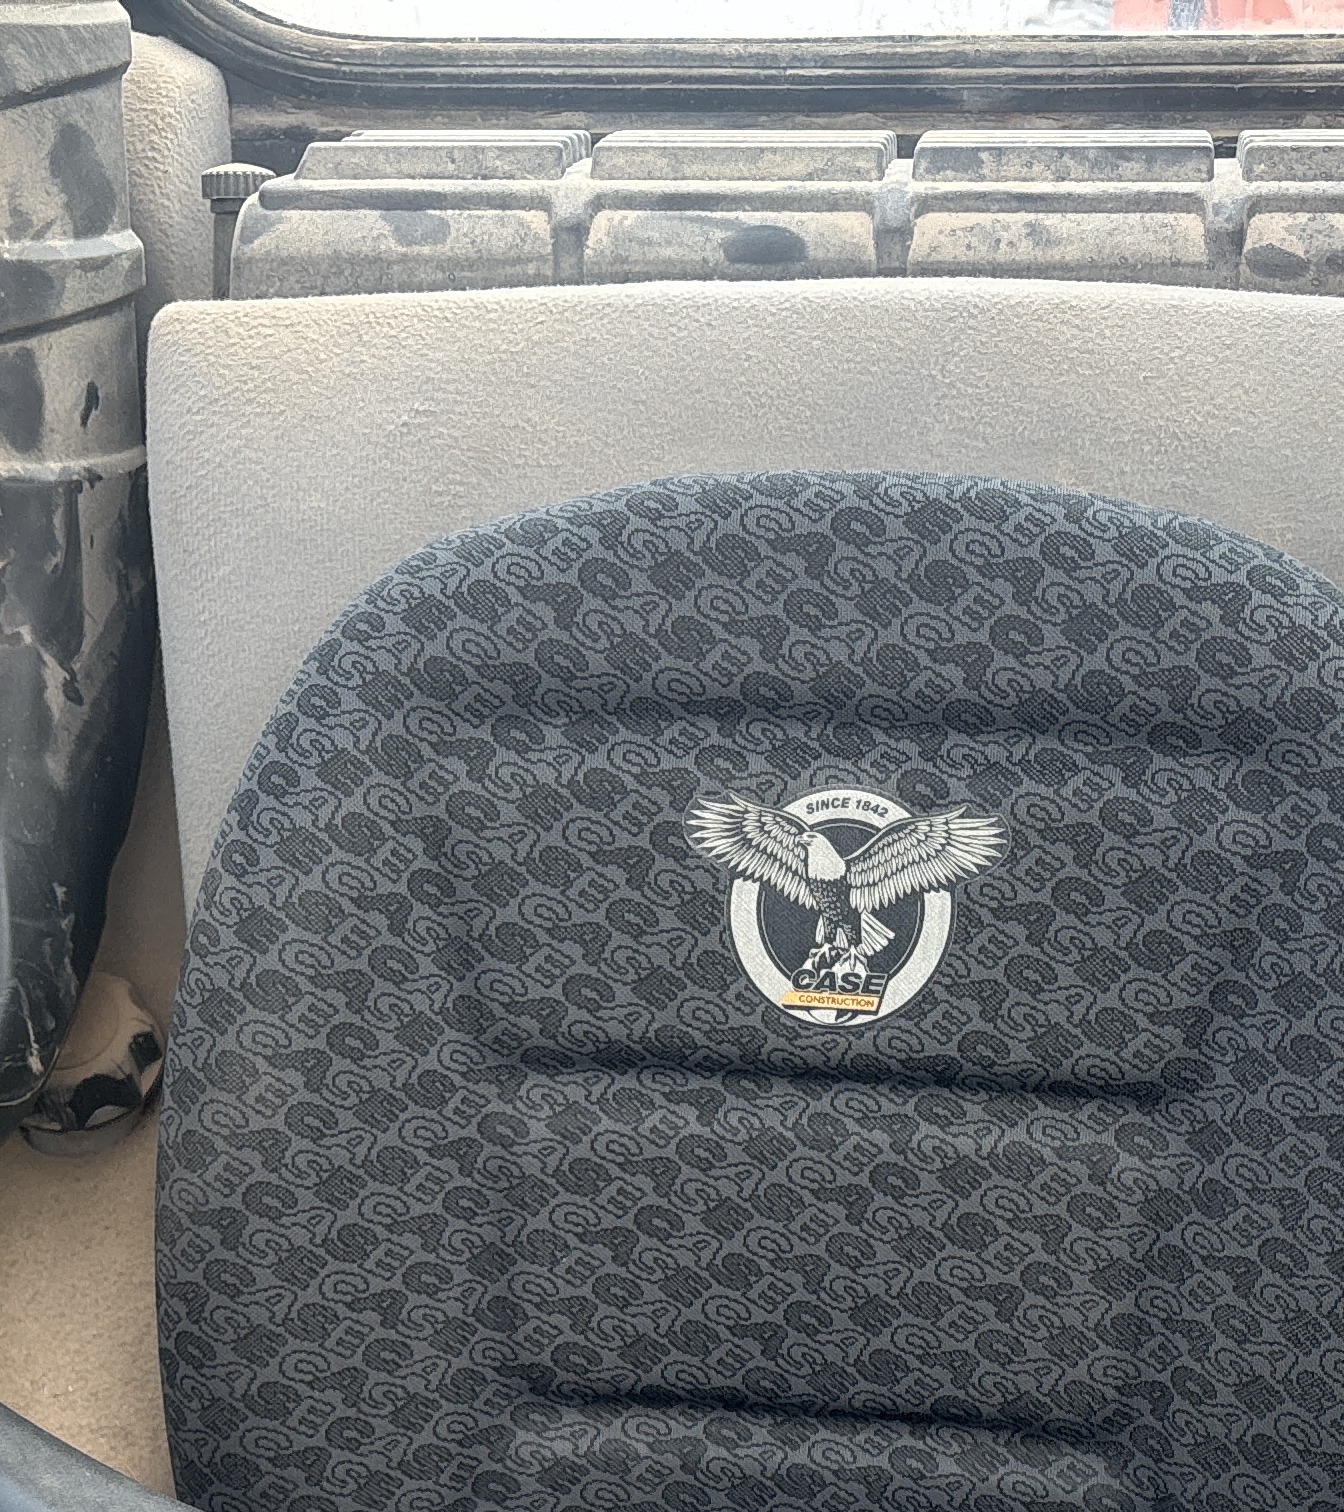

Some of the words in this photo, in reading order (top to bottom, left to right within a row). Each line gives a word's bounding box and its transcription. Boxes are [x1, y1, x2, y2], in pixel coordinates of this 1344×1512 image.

[805, 796, 851, 815] SINCE
[855, 799, 889, 818] 1842
[791, 968, 888, 997] CASE
[798, 994, 875, 1008] CONSTRUCTION
